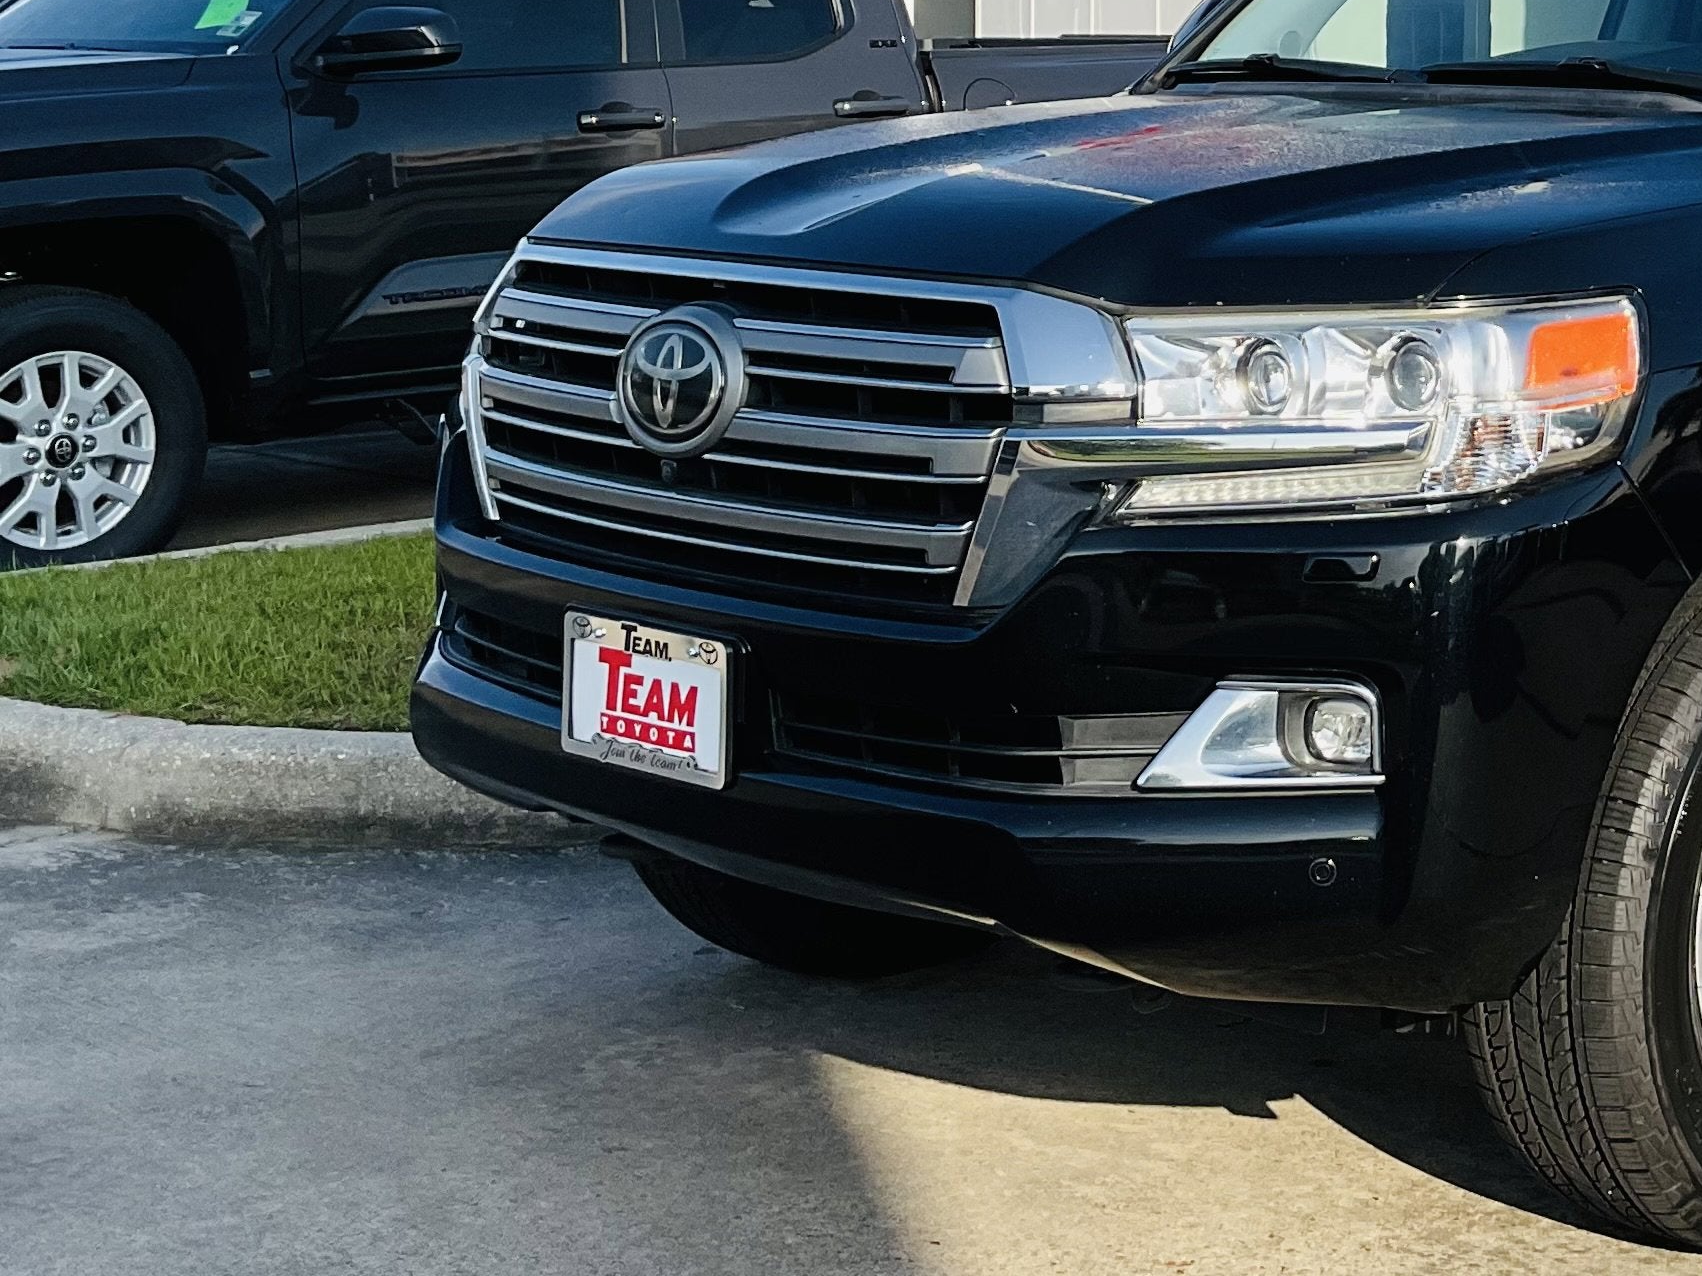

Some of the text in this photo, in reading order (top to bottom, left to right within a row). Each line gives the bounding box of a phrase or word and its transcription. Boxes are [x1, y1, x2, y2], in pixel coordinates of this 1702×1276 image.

[598, 646, 699, 728] TEAM
[600, 716, 694, 749] TOYOTA
[600, 738, 626, 762] Join
[629, 748, 647, 764] the
